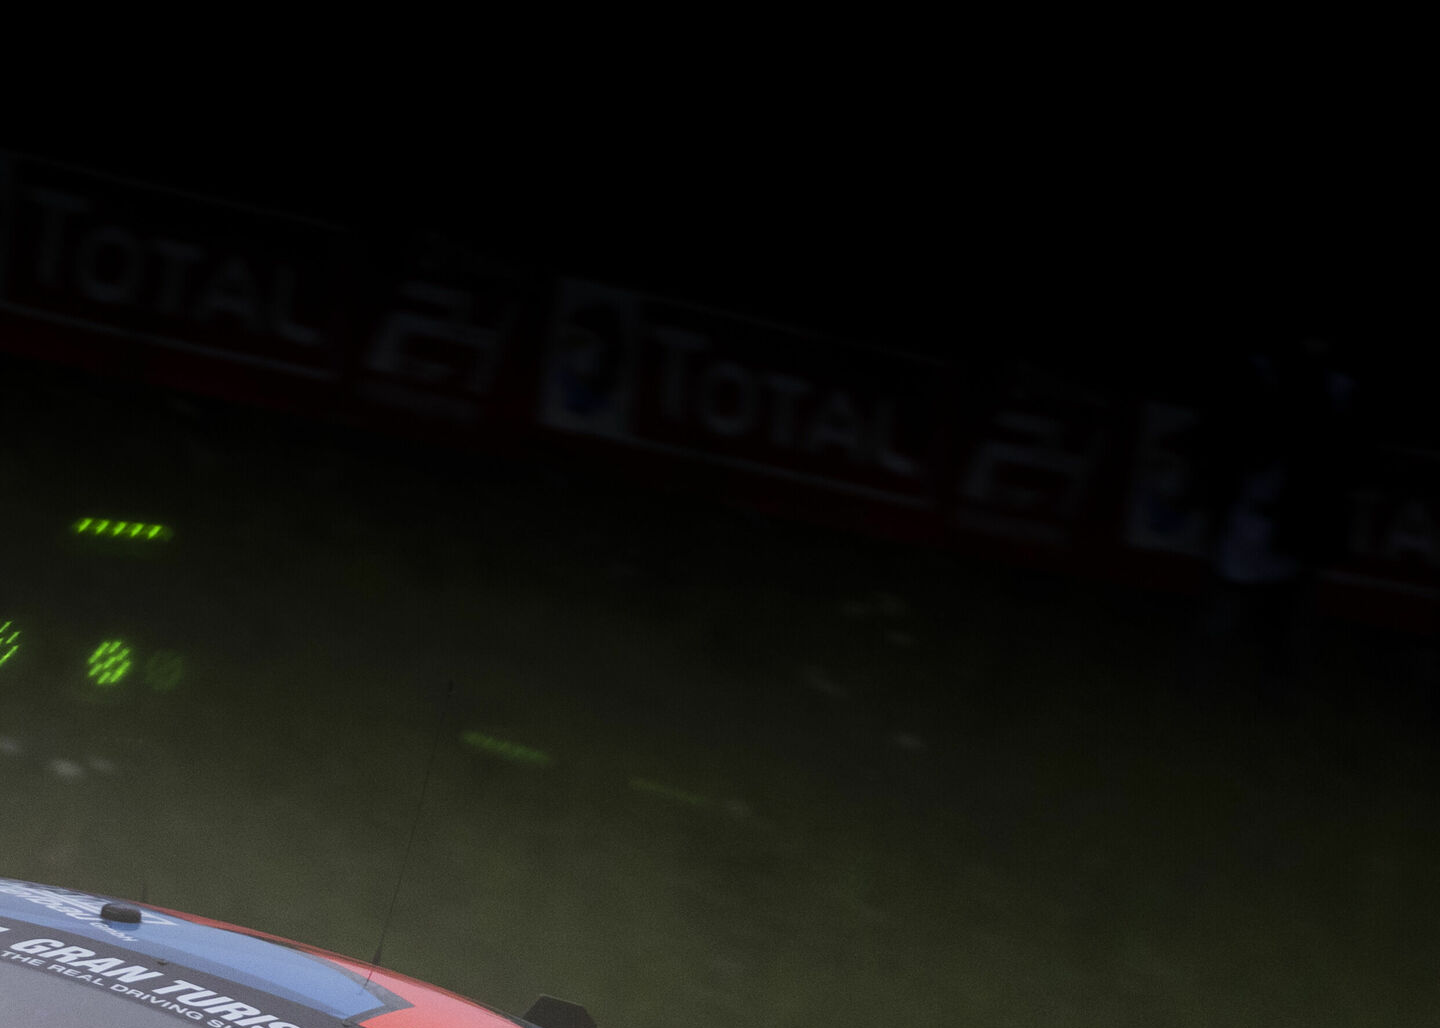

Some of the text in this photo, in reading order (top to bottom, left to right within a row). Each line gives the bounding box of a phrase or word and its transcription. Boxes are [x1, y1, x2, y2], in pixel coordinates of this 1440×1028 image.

[26, 184, 328, 347] TOTAL
[650, 324, 921, 476] TOTAL
[1, 950, 47, 968] THE
[48, 963, 103, 986] REAL
[111, 983, 204, 1021] DRIVING
[10, 938, 164, 983] GRAN
